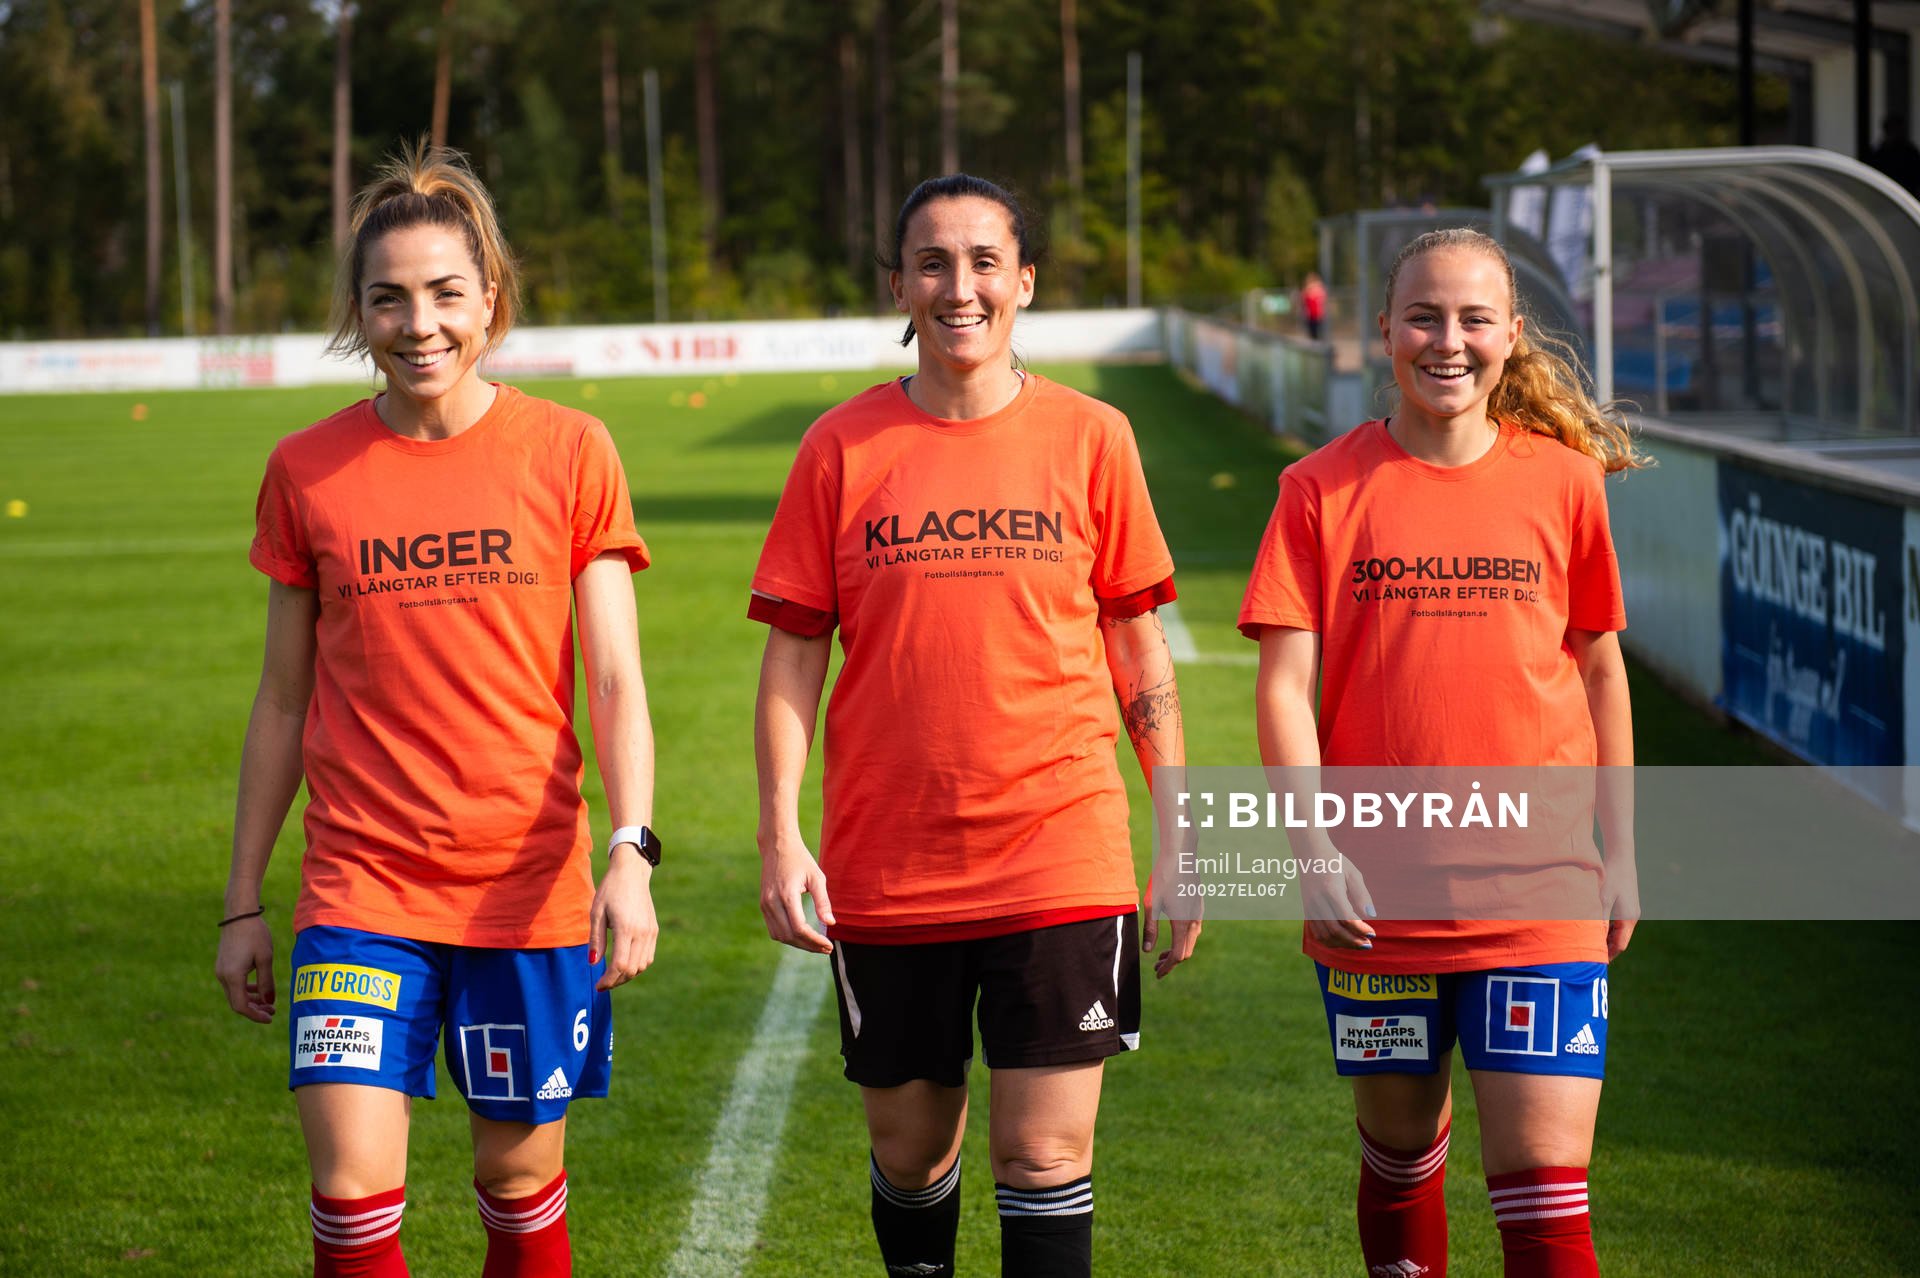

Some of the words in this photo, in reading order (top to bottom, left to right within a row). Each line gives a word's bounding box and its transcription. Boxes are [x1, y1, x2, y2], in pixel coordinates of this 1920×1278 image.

[865, 508, 1063, 552] KLACKEN
[359, 528, 513, 575] INGER
[865, 555, 880, 570] VI
[884, 547, 964, 566] LÄNGTAR
[971, 546, 1027, 560] EFTER
[1033, 550, 1063, 563] DIG!
[924, 569, 1005, 580] Fotbollslängtan.se
[1351, 556, 1541, 585] 300-KLUBBEN
[1730, 492, 1828, 625] GÖINGE
[1831, 541, 1886, 651] BIL
[337, 583, 351, 598] VI
[356, 575, 438, 596] LÄNGTAR
[444, 571, 501, 587] EFTER
[507, 571, 539, 585] DIG!
[1352, 589, 1370, 602] VI
[1374, 585, 1450, 600] LÄNGTAR
[1457, 587, 1509, 600] EFTER
[398, 597, 479, 609] Fotbollslängtan.se
[1411, 609, 1488, 618] Fotbollslängtan.se
[296, 970, 329, 995] CITY
[331, 970, 394, 1002] GROSS
[1333, 968, 1365, 994] CITY
[1368, 974, 1431, 995] GROSS
[1592, 977, 1608, 1020] 18
[572, 1008, 589, 1052] 6
[1079, 1018, 1115, 1031] adidas
[1347, 1027, 1416, 1038] HYNGARPS
[303, 1029, 370, 1042] HYNGARPS
[1340, 1037, 1424, 1049] FRÄSTEKNIK
[298, 1040, 376, 1055] FRÄSTEKNIK
[1564, 1041, 1599, 1055] adidas
[536, 1085, 573, 1100] adidas
